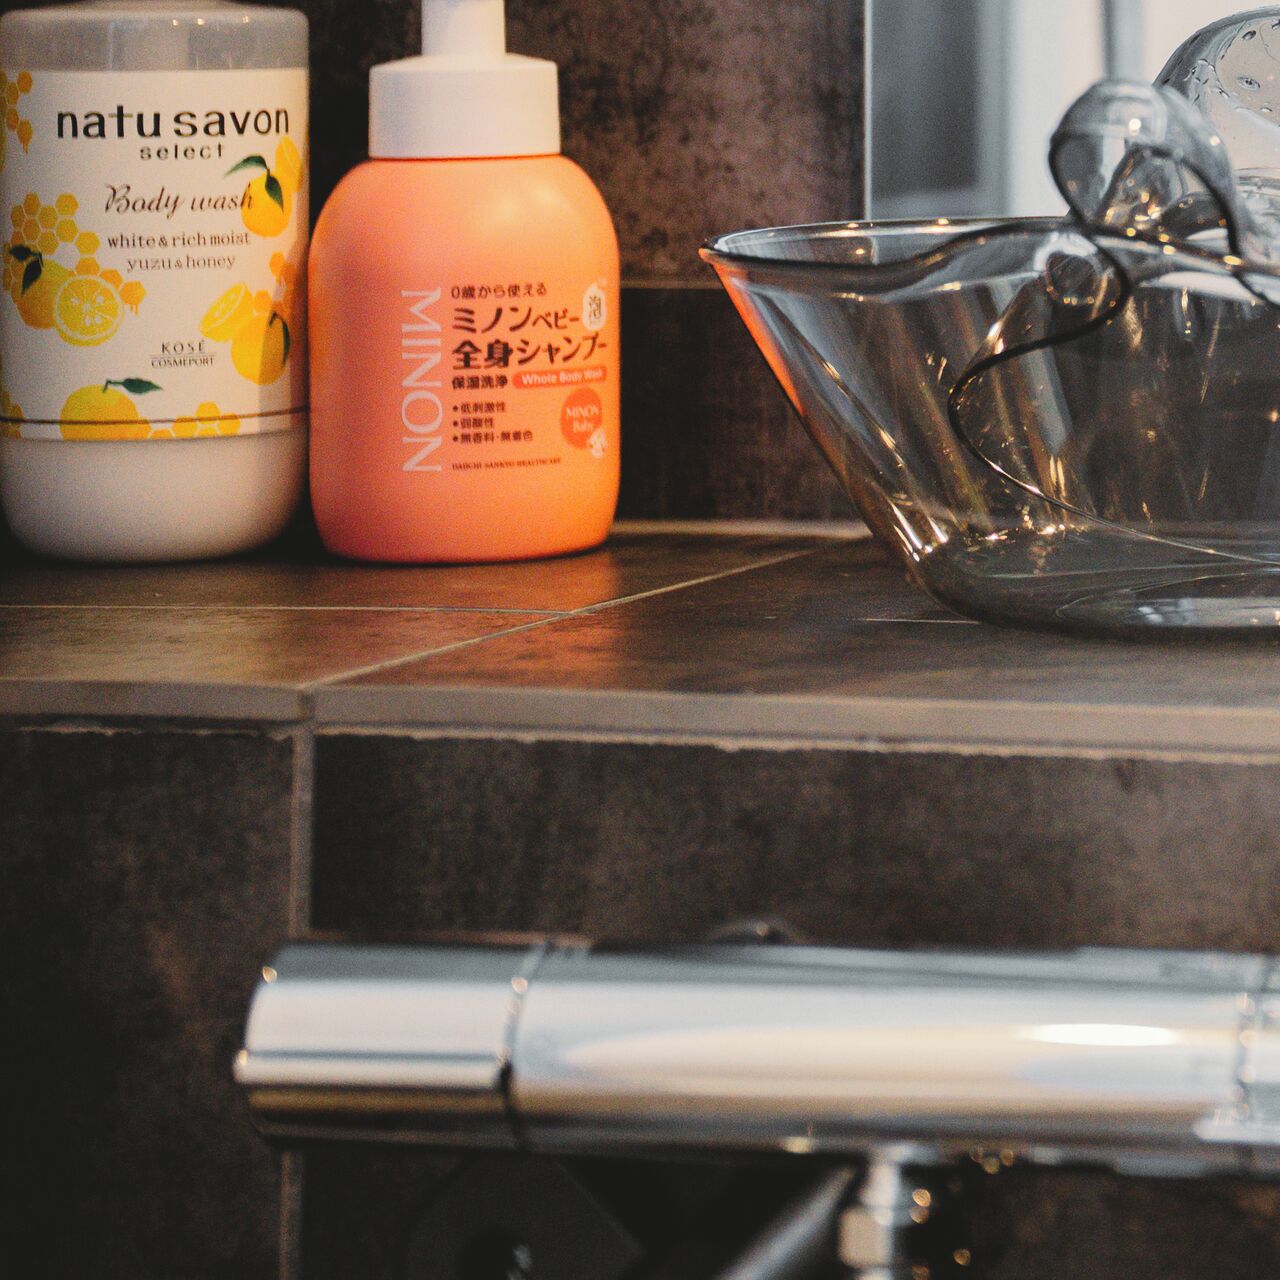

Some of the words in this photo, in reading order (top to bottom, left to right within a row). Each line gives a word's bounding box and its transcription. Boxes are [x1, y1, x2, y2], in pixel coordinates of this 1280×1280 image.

[57, 104, 161, 139] natu
[173, 108, 289, 137] savon
[139, 141, 224, 160] select
[103, 183, 184, 220] Body
[189, 182, 253, 214] wash
[209, 230, 250, 246] moist
[451, 332, 608, 370] 全身シャンプー
[400, 286, 443, 473] MINON
[521, 373, 558, 385] Whole
